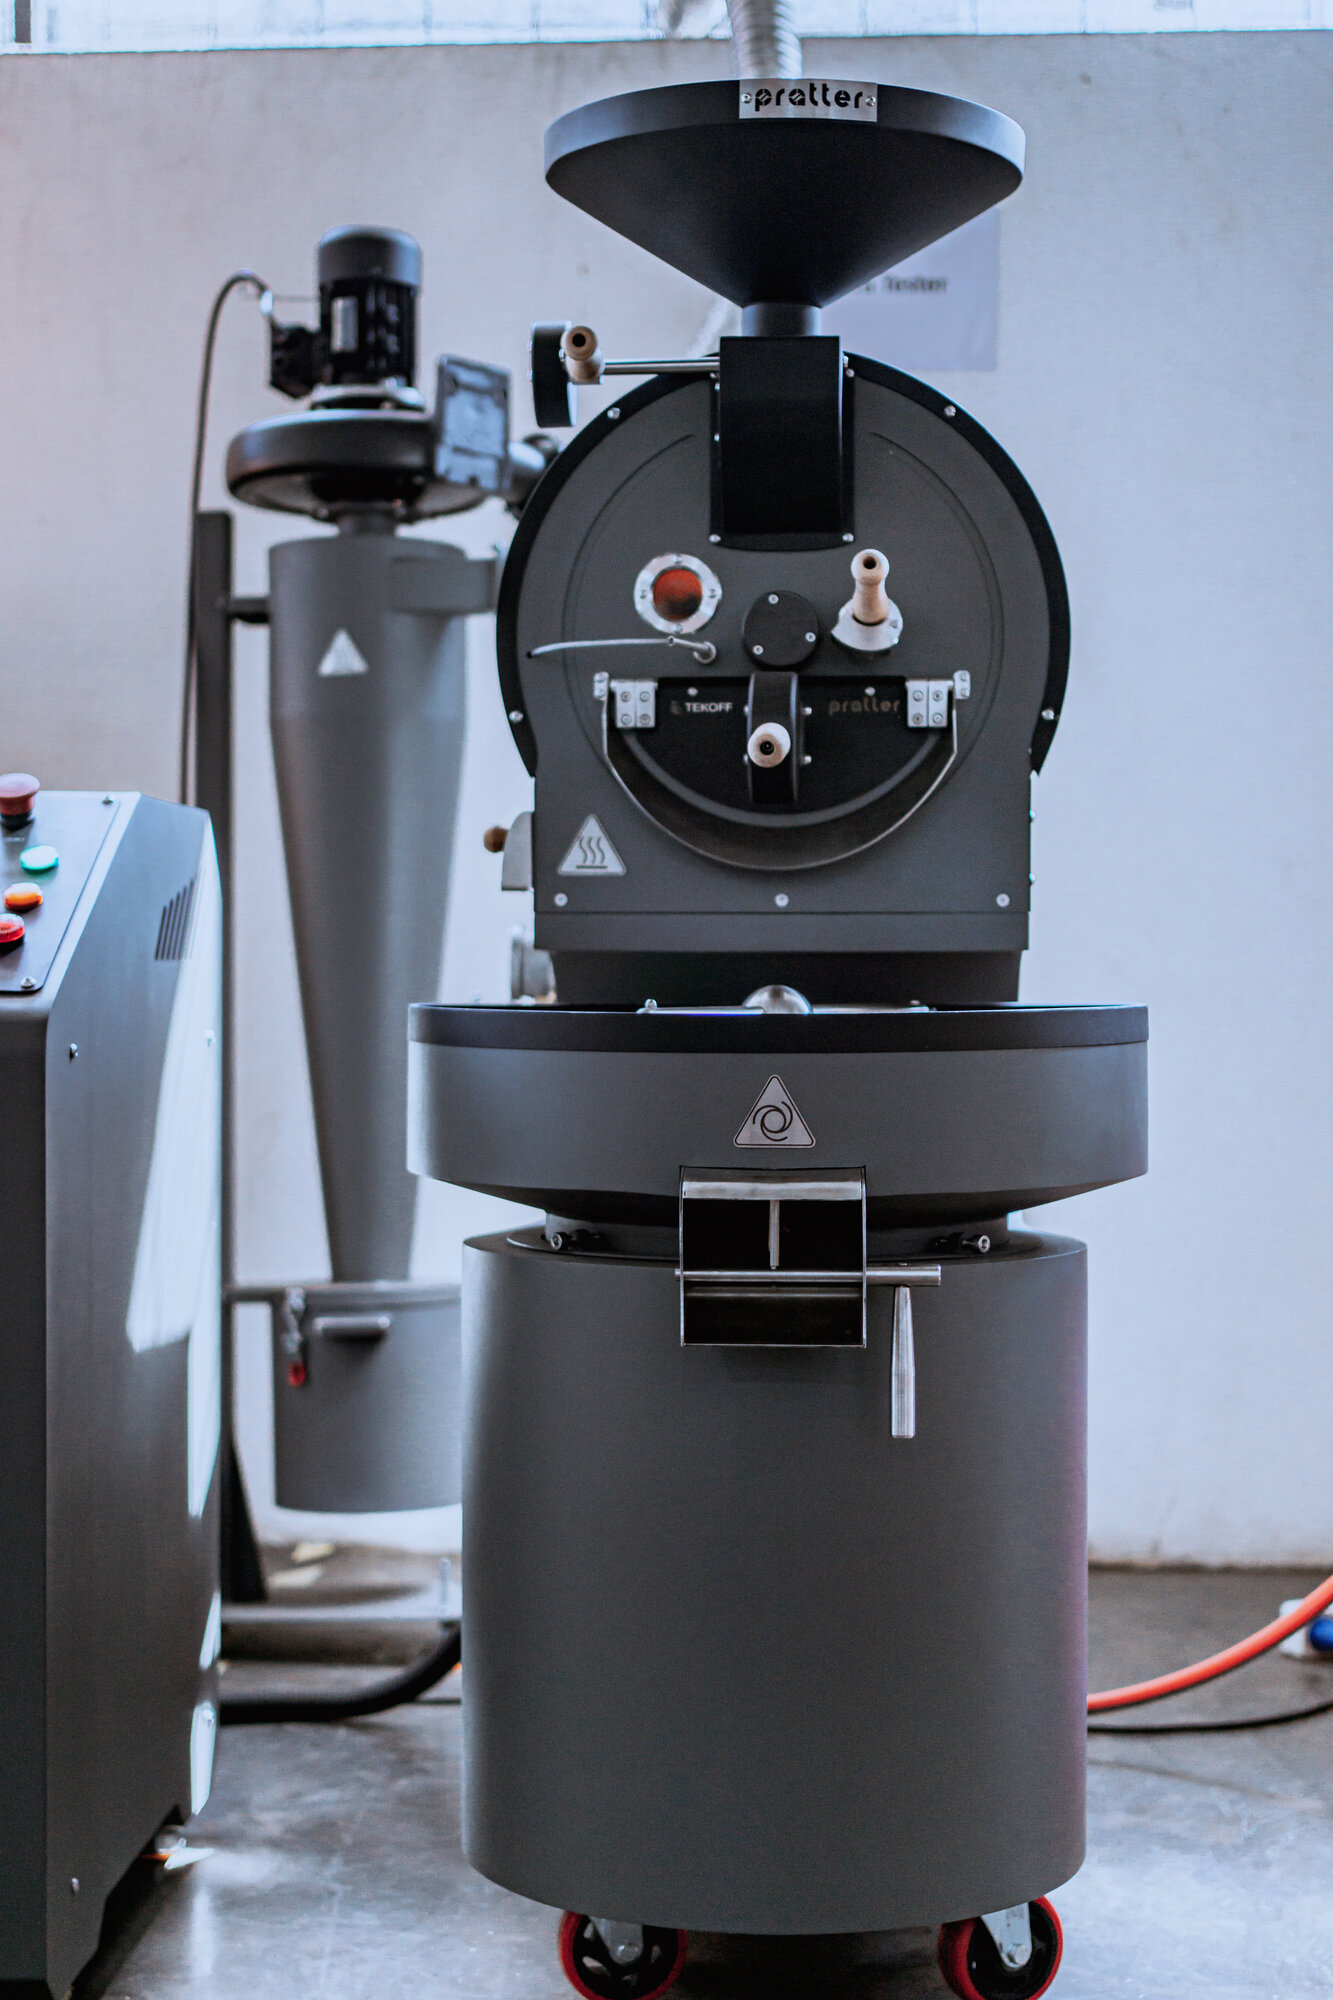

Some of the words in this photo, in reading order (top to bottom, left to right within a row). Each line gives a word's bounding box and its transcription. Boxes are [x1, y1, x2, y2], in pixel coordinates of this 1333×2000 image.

[755, 83, 863, 112] pratter
[685, 702, 733, 713] TEKOFF
[829, 697, 900, 716] pratter
